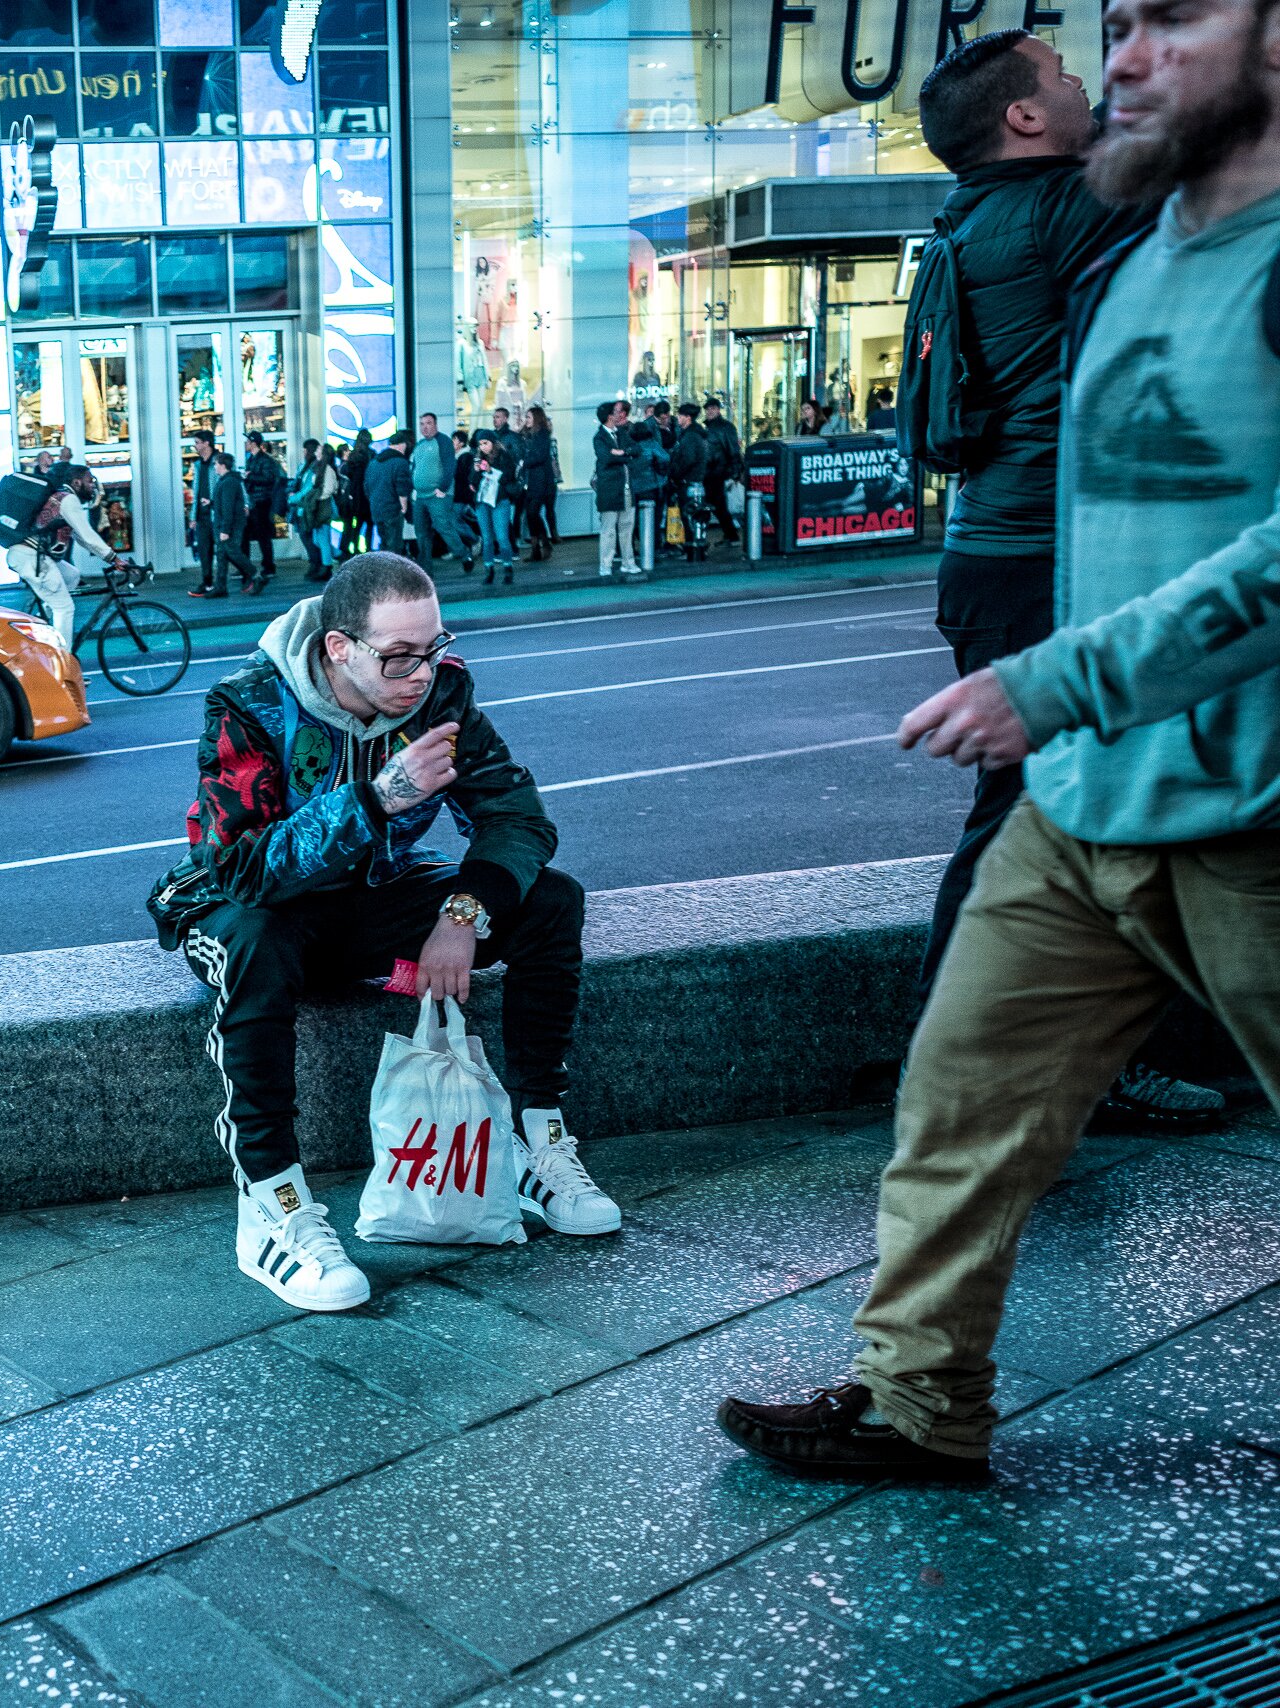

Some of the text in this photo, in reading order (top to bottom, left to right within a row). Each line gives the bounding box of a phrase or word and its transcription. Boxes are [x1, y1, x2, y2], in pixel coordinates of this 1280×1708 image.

[800, 448, 899, 470] BROADWAY'S
[800, 464, 893, 485] SURE THING
[797, 506, 915, 539] CHICAGO
[387, 1117, 492, 1198] H&M
